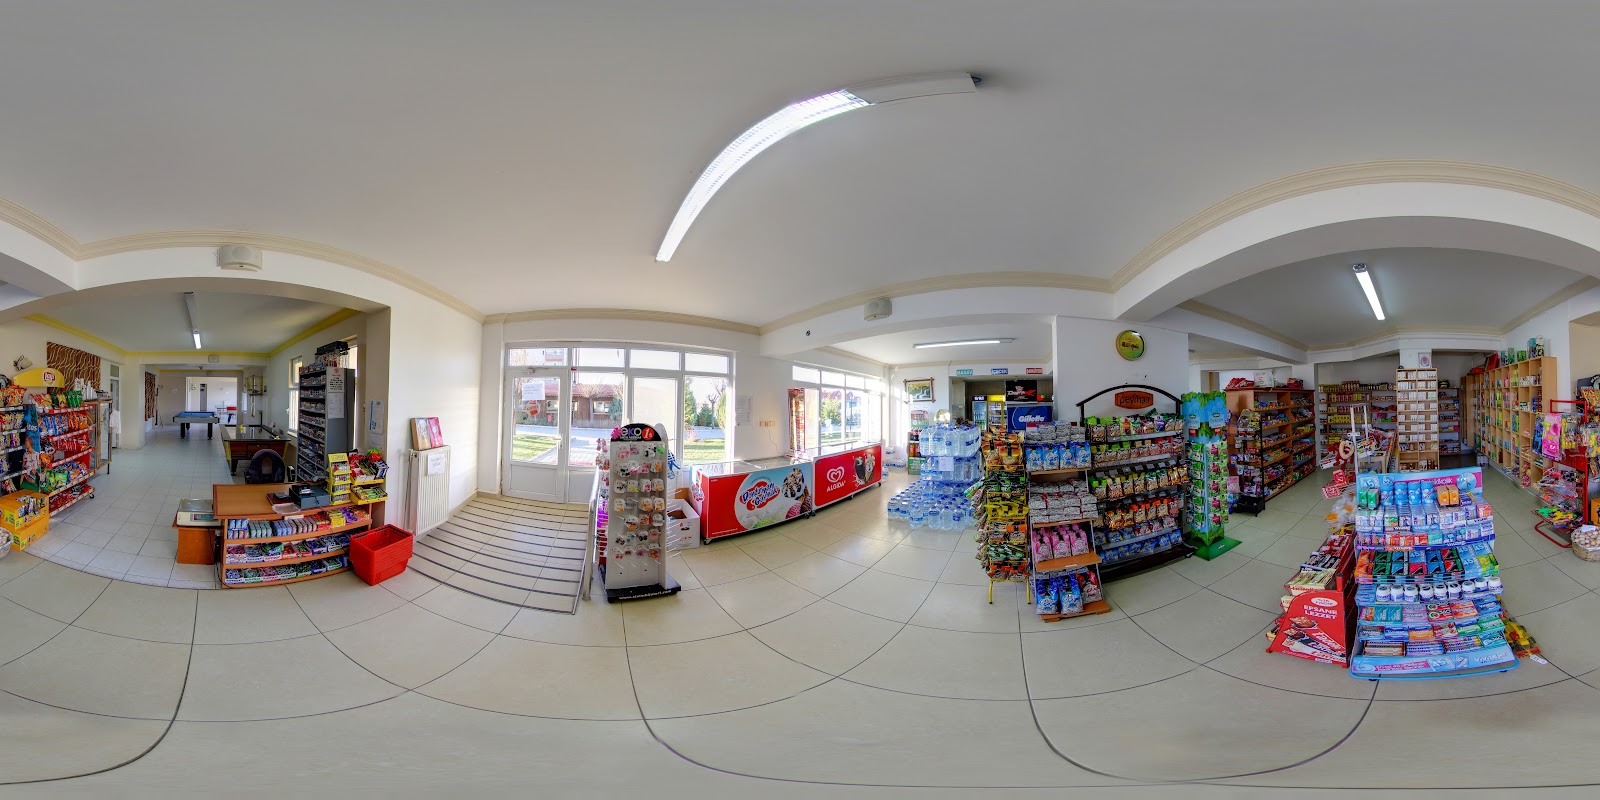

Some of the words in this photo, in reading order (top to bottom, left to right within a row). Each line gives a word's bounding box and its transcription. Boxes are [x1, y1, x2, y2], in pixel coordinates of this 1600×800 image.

[1018, 414, 1045, 424] Gillette
[826, 481, 845, 492] ALGIDA
[1303, 604, 1337, 615] EFSANE
[1304, 610, 1337, 620] LEZZET
